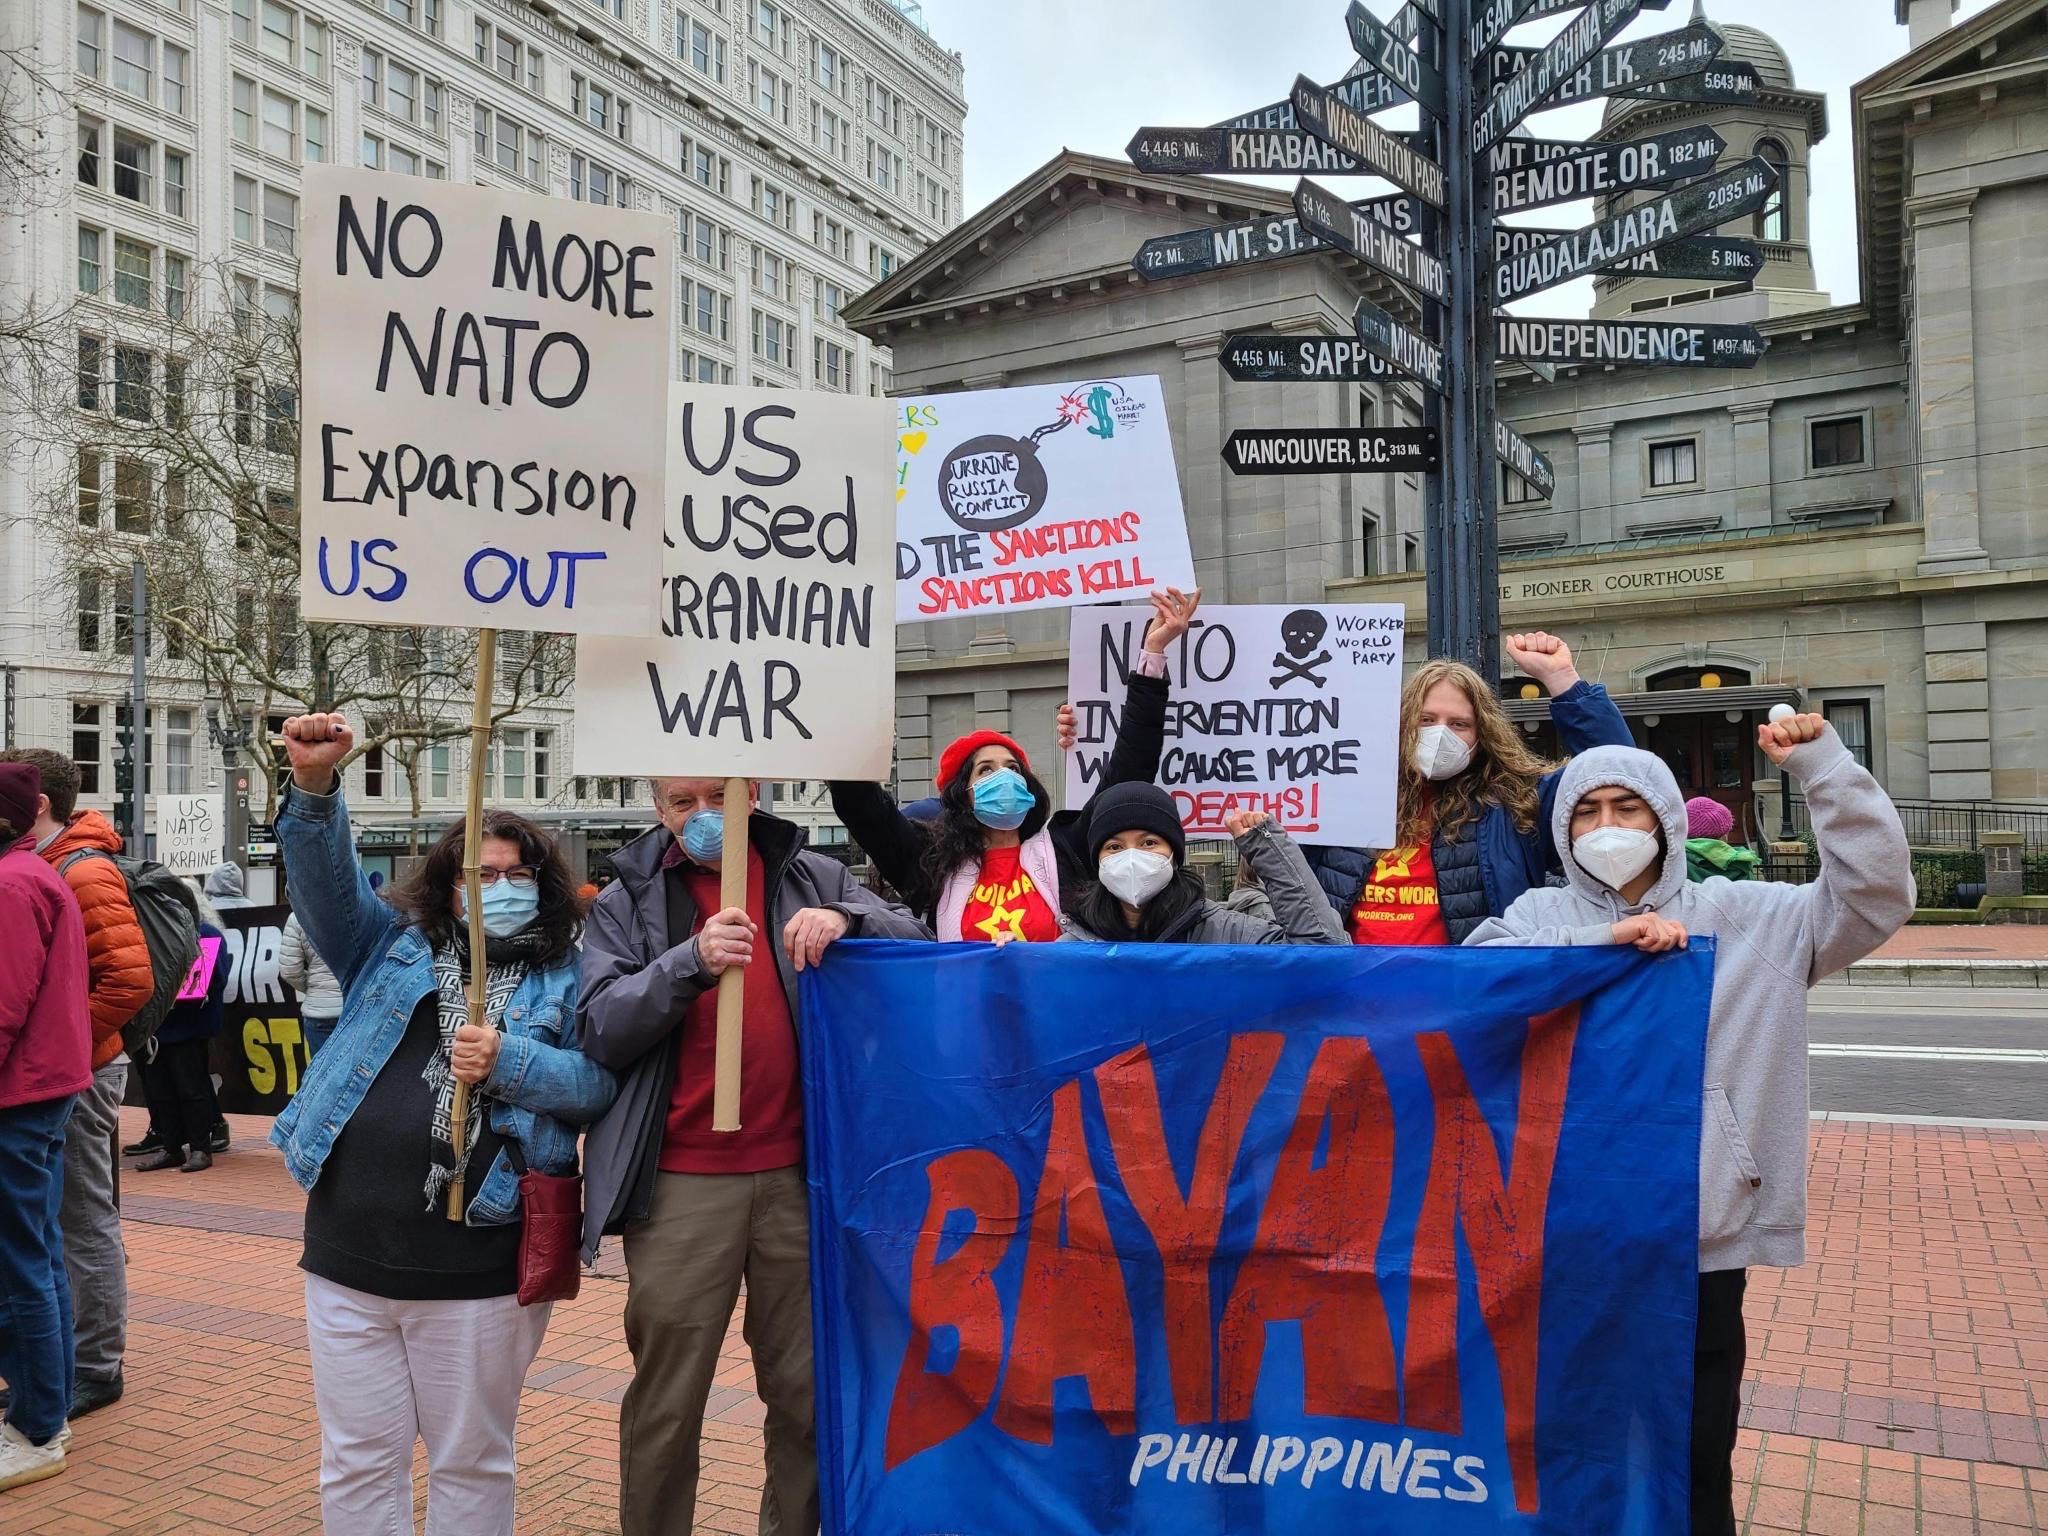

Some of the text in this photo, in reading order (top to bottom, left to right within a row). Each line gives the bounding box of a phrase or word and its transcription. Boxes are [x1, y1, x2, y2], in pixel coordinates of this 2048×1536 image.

[1381, 28, 1419, 93] ZOO
[1602, 48, 1640, 89] LK.
[1658, 44, 1686, 66] 245
[1689, 38, 1712, 57] Mi.
[1500, 68, 1535, 128] WALL
[1184, 142, 1203, 158] Mi.
[1326, 94, 1411, 187] WASHINGTON
[1415, 156, 1443, 206] PARK
[1495, 151, 1616, 210] REMOTE,
[1619, 142, 1667, 182] OR.
[1669, 144, 1693, 165] 182
[1697, 138, 1719, 158] Mi.
[337, 195, 656, 319] NO MORE
[1147, 218, 1304, 268] 72 Mi. MT. ST.
[1302, 193, 1314, 213] 54
[1351, 211, 1411, 279] TRI-MET
[1416, 250, 1443, 296] INFO
[1497, 199, 1679, 298] GUADALAJARA
[1708, 179, 1743, 210] 2,035
[1746, 172, 1766, 195] Mi.
[1711, 250, 1754, 267] 5 Blks.
[376, 307, 589, 409] NATO
[1232, 350, 1264, 367] 4,456
[1269, 350, 1287, 367] Mi.
[1391, 322, 1442, 386] MUTARE
[1500, 322, 1705, 361] INDEPENDENCE
[682, 402, 801, 486] US
[951, 453, 1017, 480] UKRAINE
[1235, 438, 1422, 465] VANCOUVER, B.C. 313 Mi.
[1511, 433, 1533, 476] POND
[321, 424, 637, 530] Expansion
[948, 480, 1009, 500] RUSSIA
[955, 494, 1028, 517] CONFLICT
[921, 532, 983, 577] THE
[989, 511, 1141, 566] SANCTIONS
[319, 536, 607, 608] US OUT
[919, 556, 1154, 614] SANCTIONS KILL
[1522, 578, 1593, 598] PIONEER
[1605, 567, 1725, 590] COURTHOUSE
[1336, 615, 1405, 631] WORKER
[1336, 635, 1392, 648] WORLD
[1353, 650, 1396, 665] PARTY
[646, 660, 812, 743] WAR
[1076, 697, 1340, 744] INERVENTION
[1161, 739, 1361, 785] CAUSE MORE
[165, 817, 213, 835] NATO
[1171, 782, 1320, 826] DEATHS!
[162, 849, 218, 869] UKRAINE
[1357, 910, 1415, 921] WORKERS.ORG
[1361, 884, 1396, 903] ERS
[243, 1017, 311, 1095] ST
[885, 1001, 1582, 1513] BAYAN
[1129, 1433, 1489, 1504] PHILIPPINES
